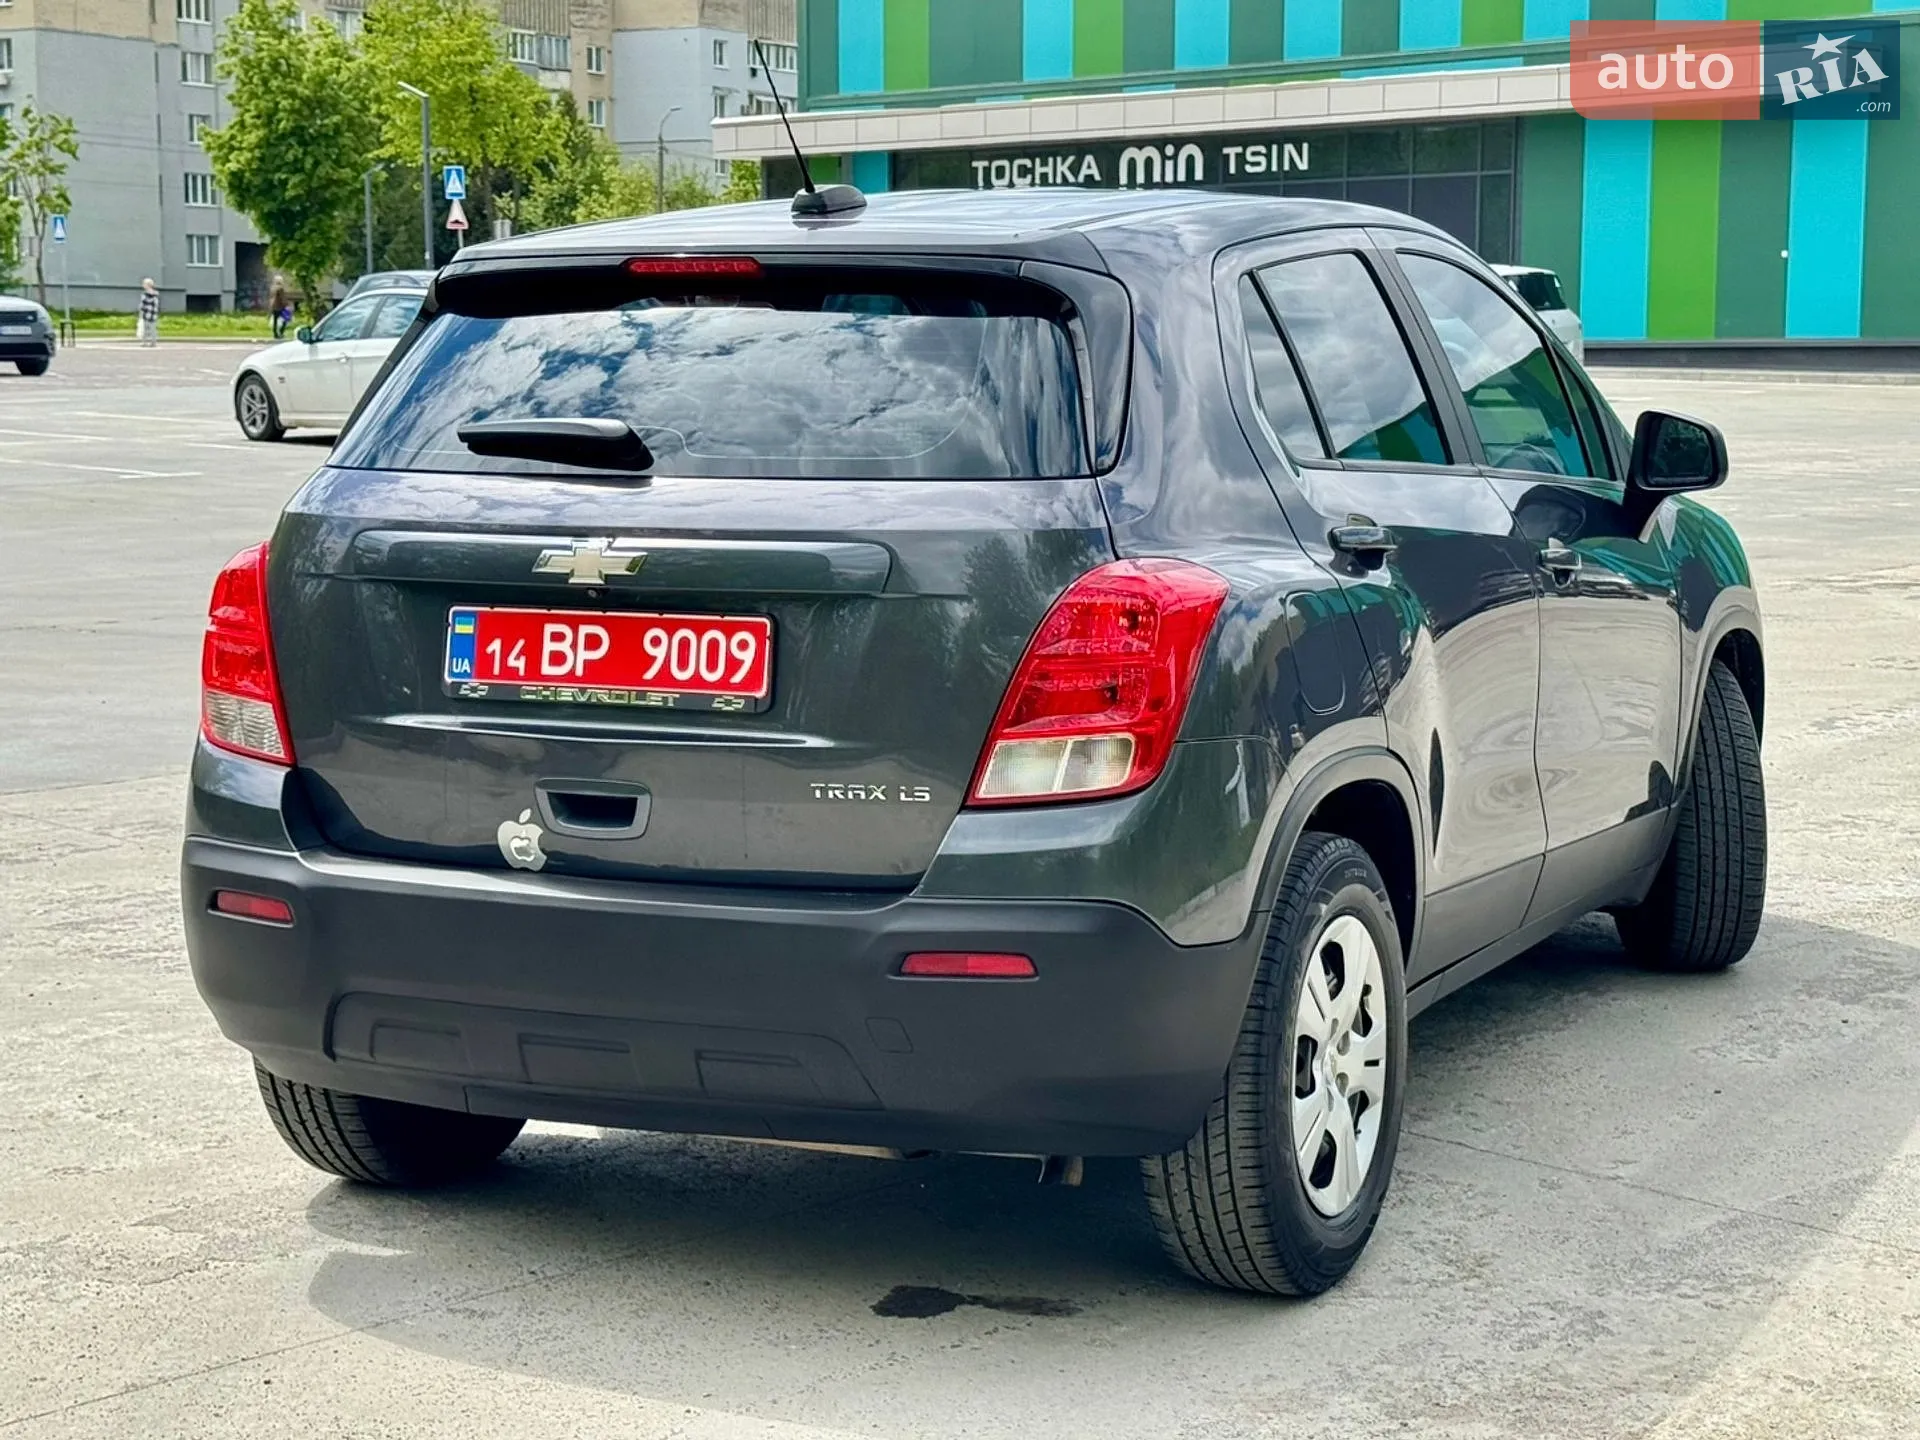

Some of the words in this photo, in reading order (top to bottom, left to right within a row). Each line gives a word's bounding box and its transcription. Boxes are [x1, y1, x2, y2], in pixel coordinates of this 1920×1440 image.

[971, 154, 1101, 187] TOCHKA
[1222, 142, 1309, 174] TSIN
[485, 637, 527, 677] 14
[540, 623, 610, 677] BP
[642, 628, 756, 684] 9009
[452, 656, 472, 675] UA
[519, 686, 680, 706] CHEVROLET
[810, 783, 887, 800] TRAX
[900, 785, 931, 802] LS
